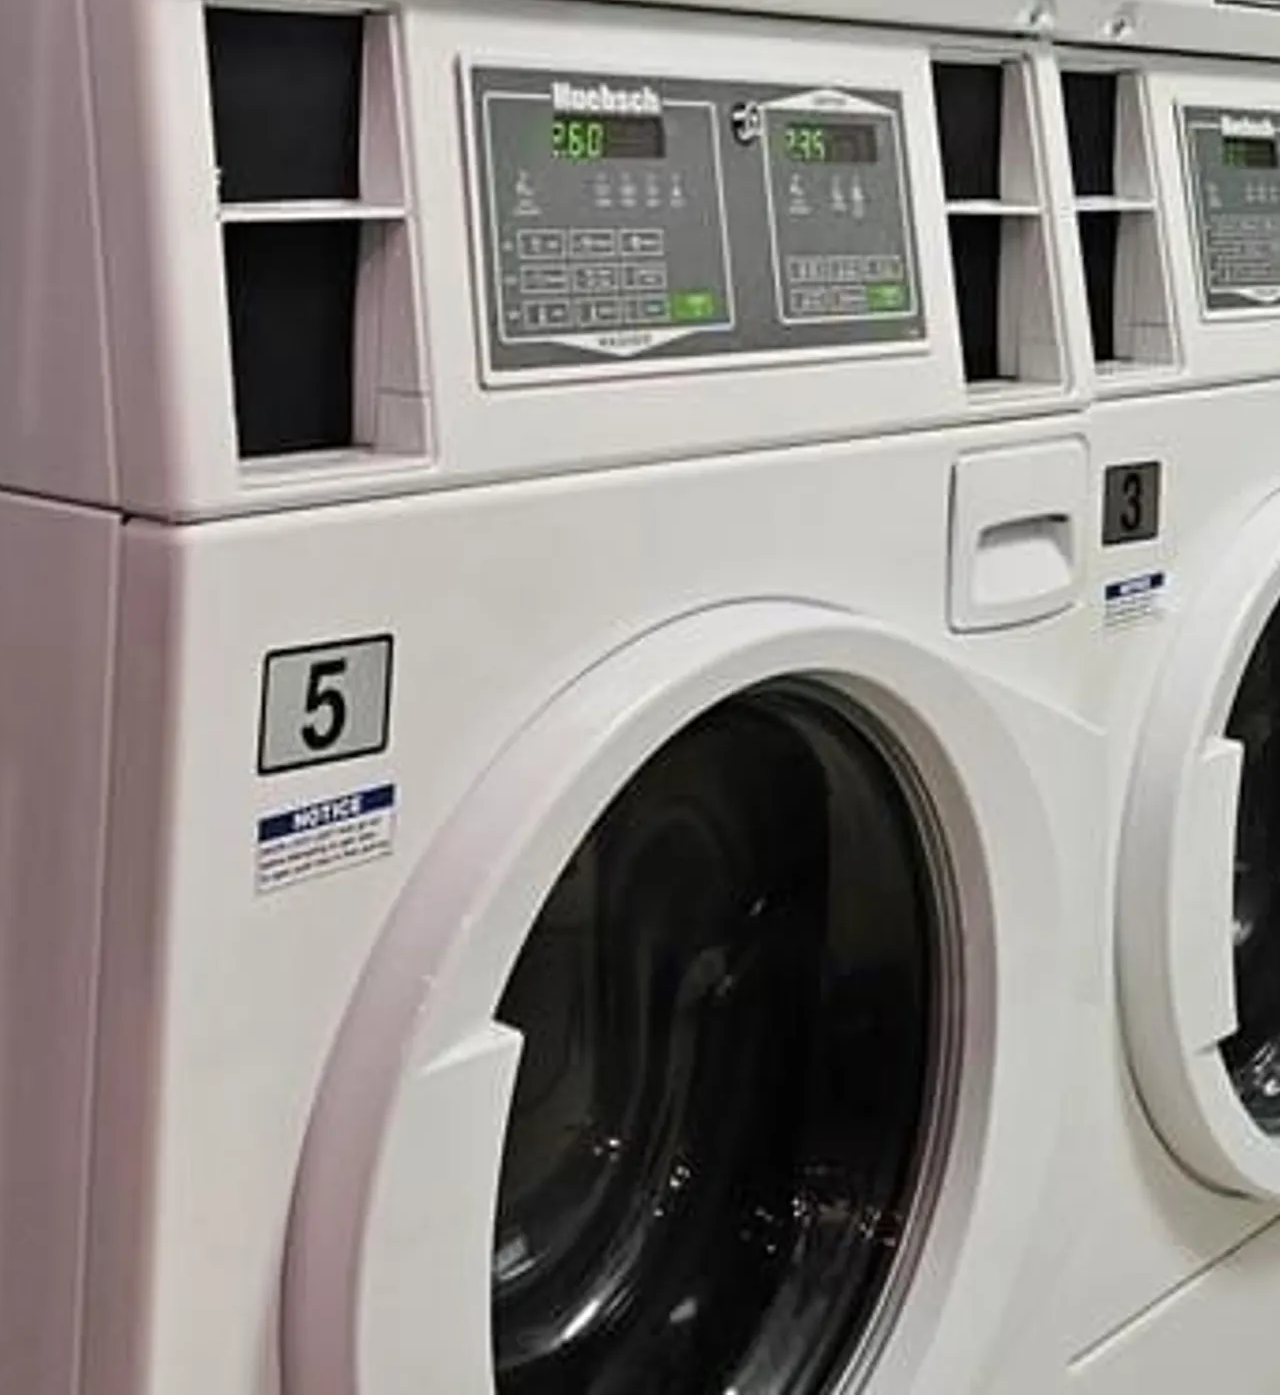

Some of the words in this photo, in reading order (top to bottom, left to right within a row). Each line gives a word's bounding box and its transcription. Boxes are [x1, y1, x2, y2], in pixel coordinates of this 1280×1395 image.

[1119, 471, 1143, 532] 3
[300, 658, 349, 752] 5
[292, 796, 362, 831] NOTICE
